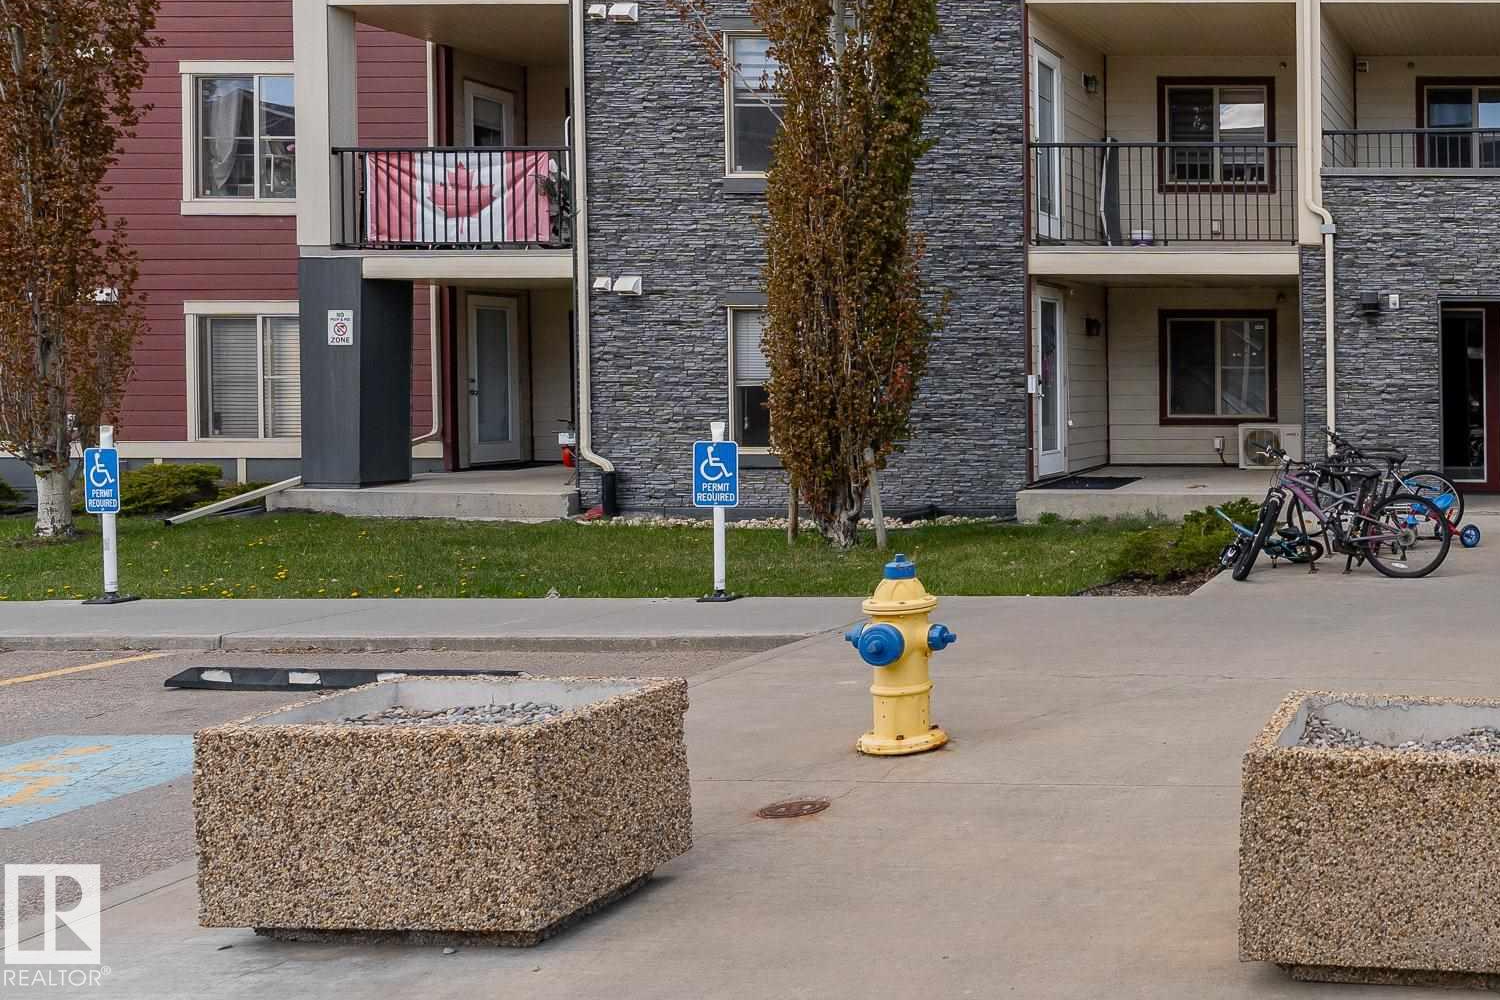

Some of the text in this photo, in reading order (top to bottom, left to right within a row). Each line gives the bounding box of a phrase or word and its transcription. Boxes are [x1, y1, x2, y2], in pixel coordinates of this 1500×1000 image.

[702, 482, 730, 492] PERMIT
[91, 489, 113, 498] PERMIT
[696, 492, 735, 503] REQUIRED
[88, 498, 118, 508] REQUIRED
